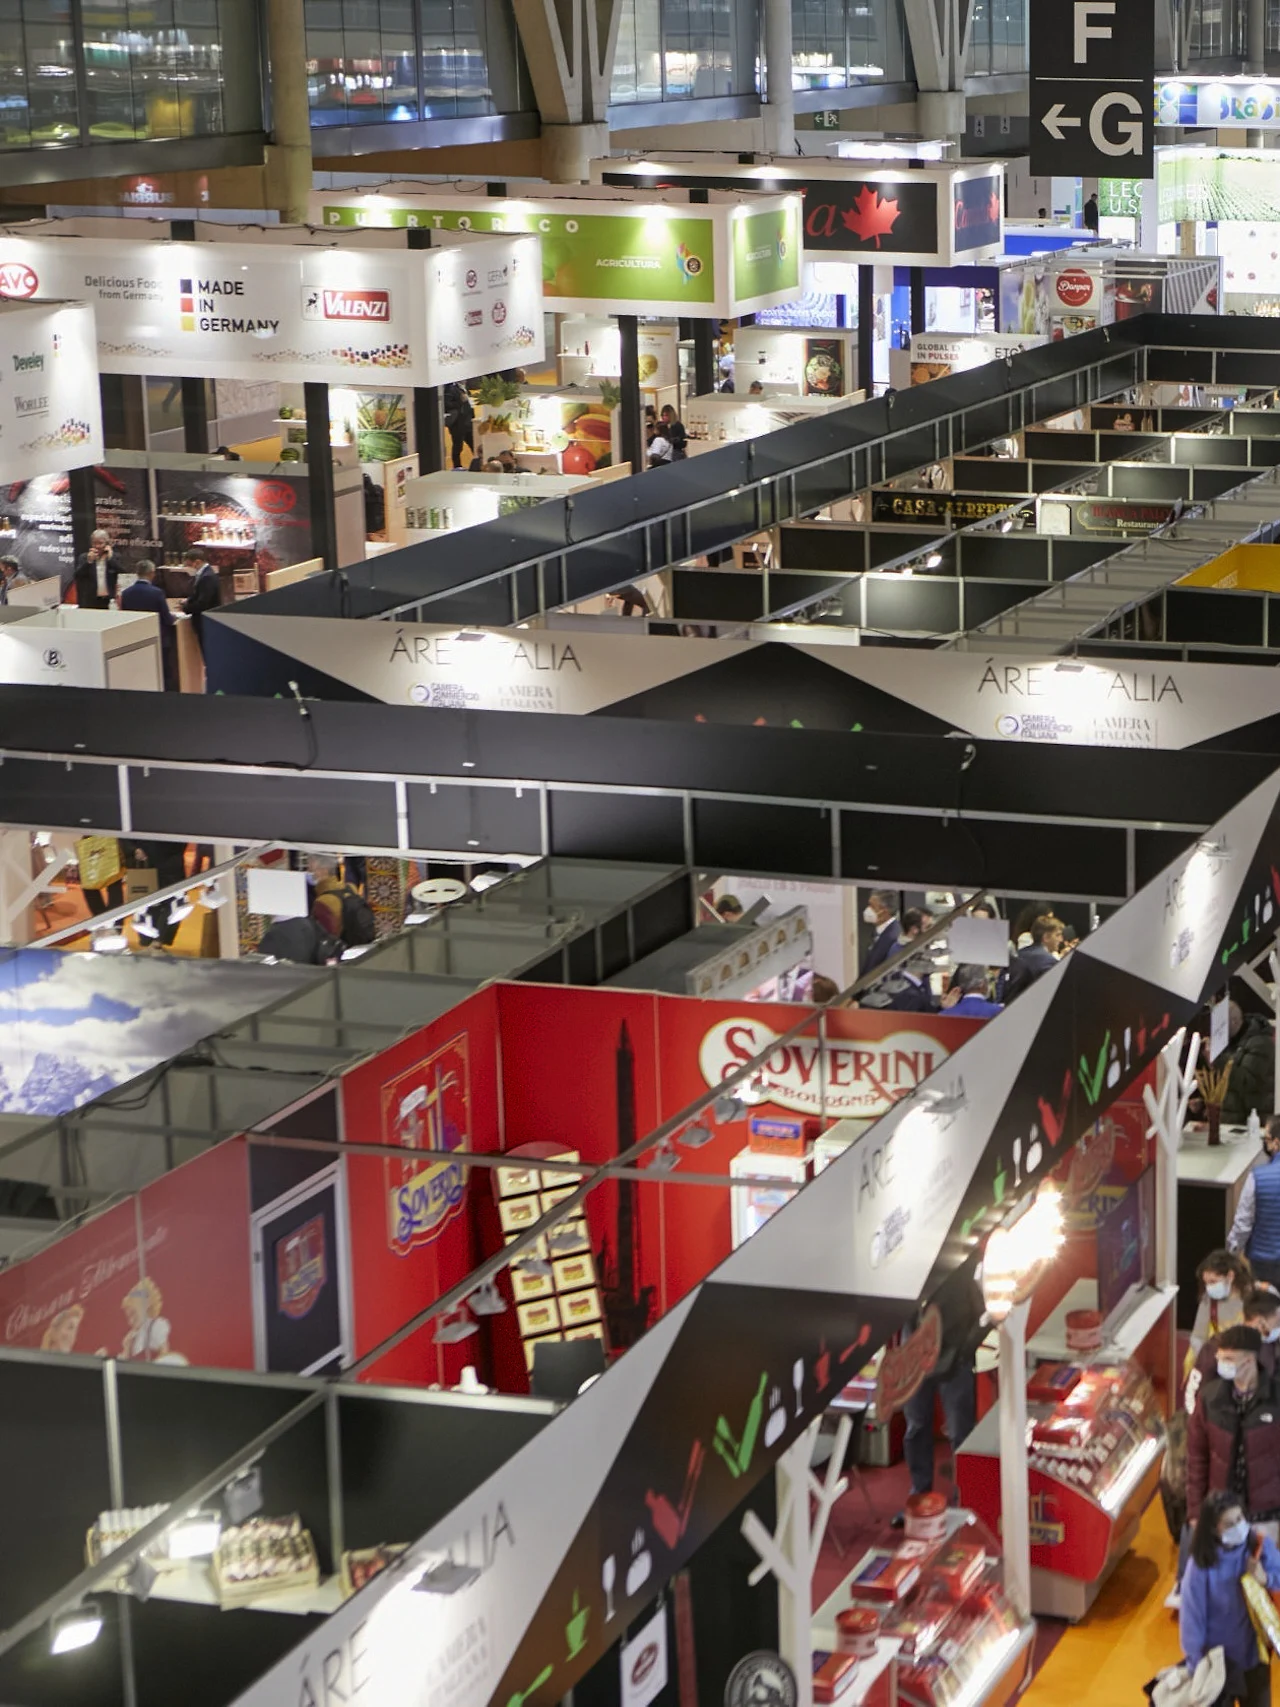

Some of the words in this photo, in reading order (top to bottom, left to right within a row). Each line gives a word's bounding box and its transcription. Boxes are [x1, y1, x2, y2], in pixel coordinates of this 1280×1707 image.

[1072, 1, 1117, 65] F
[1088, 91, 1144, 157] G
[328, 211, 472, 230] PURTO
[491, 216, 579, 234] RCO
[595, 259, 662, 269] AGRICULTURA
[84, 275, 135, 288] Delicious
[198, 280, 244, 295] MADE
[98, 290, 121, 300] from
[324, 291, 387, 317] VALENZI
[199, 299, 215, 313] IN
[199, 318, 280, 334] GERMANY
[917, 343, 949, 351] GLOBAL
[388, 627, 451, 665] ÁRE
[977, 656, 1044, 696] ÁRE
[720, 1027, 936, 1101] SOVERINI
